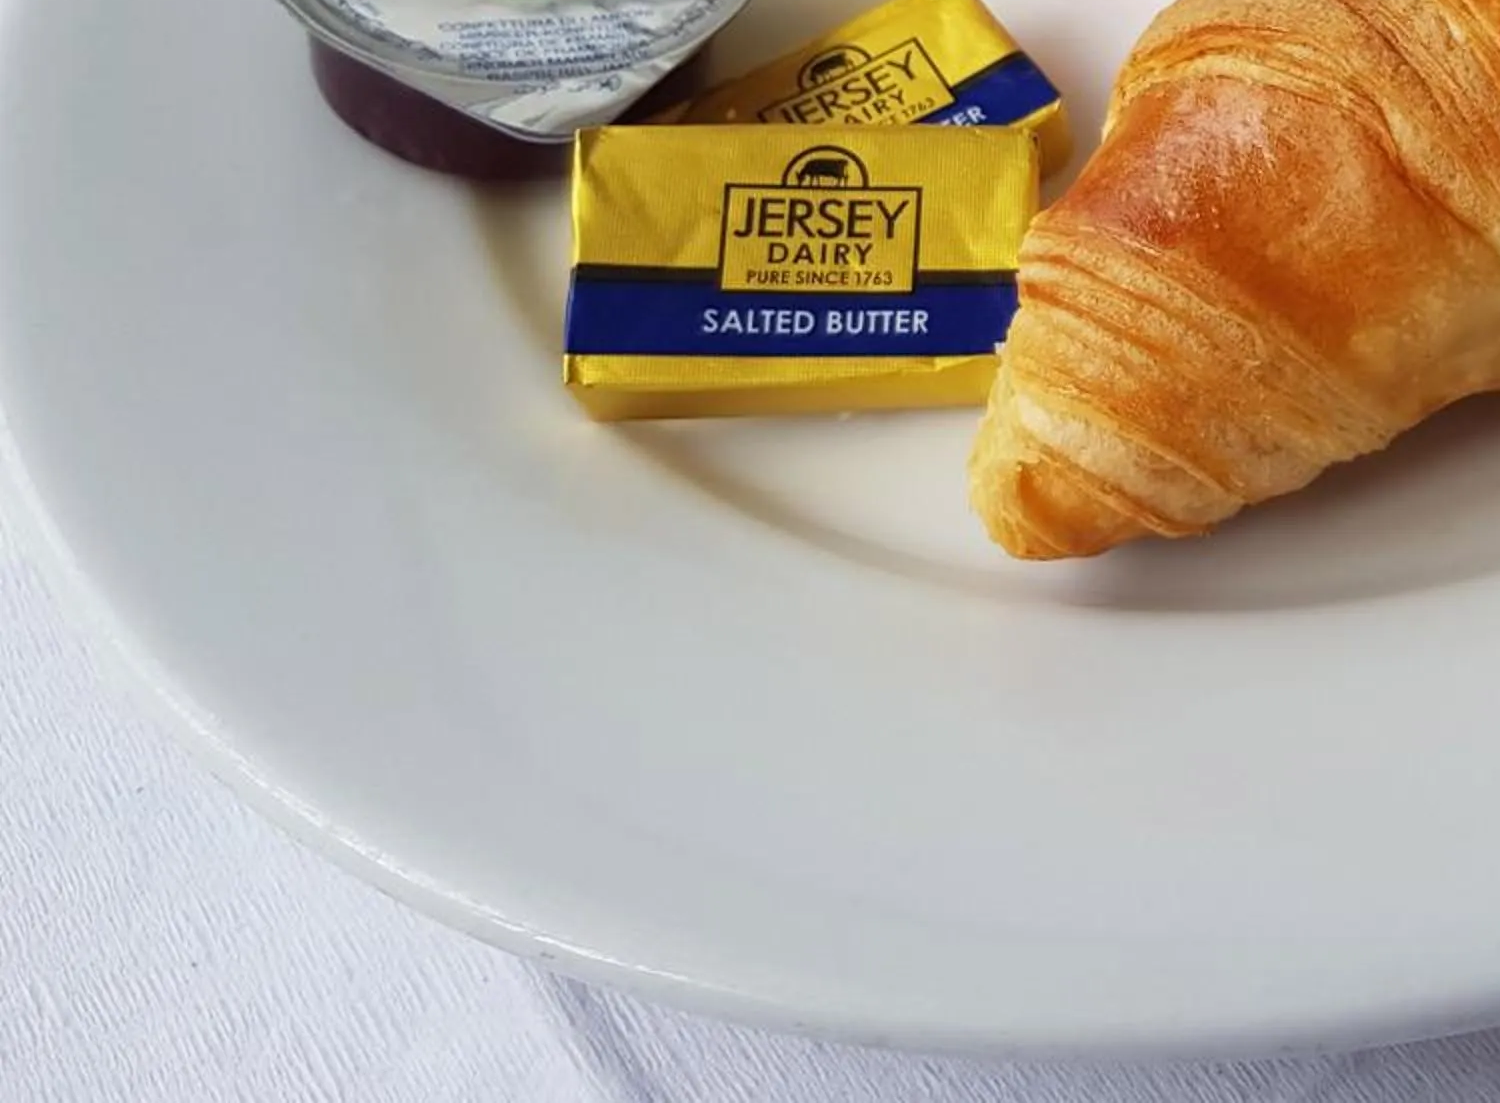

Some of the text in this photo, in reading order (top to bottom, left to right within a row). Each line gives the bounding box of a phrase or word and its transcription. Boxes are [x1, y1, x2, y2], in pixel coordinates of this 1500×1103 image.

[733, 197, 910, 240] JERSEY
[767, 242, 874, 267] DAIRY
[746, 269, 893, 286] PURE SINCE 1763
[702, 308, 929, 335] SALTED BUTTER
